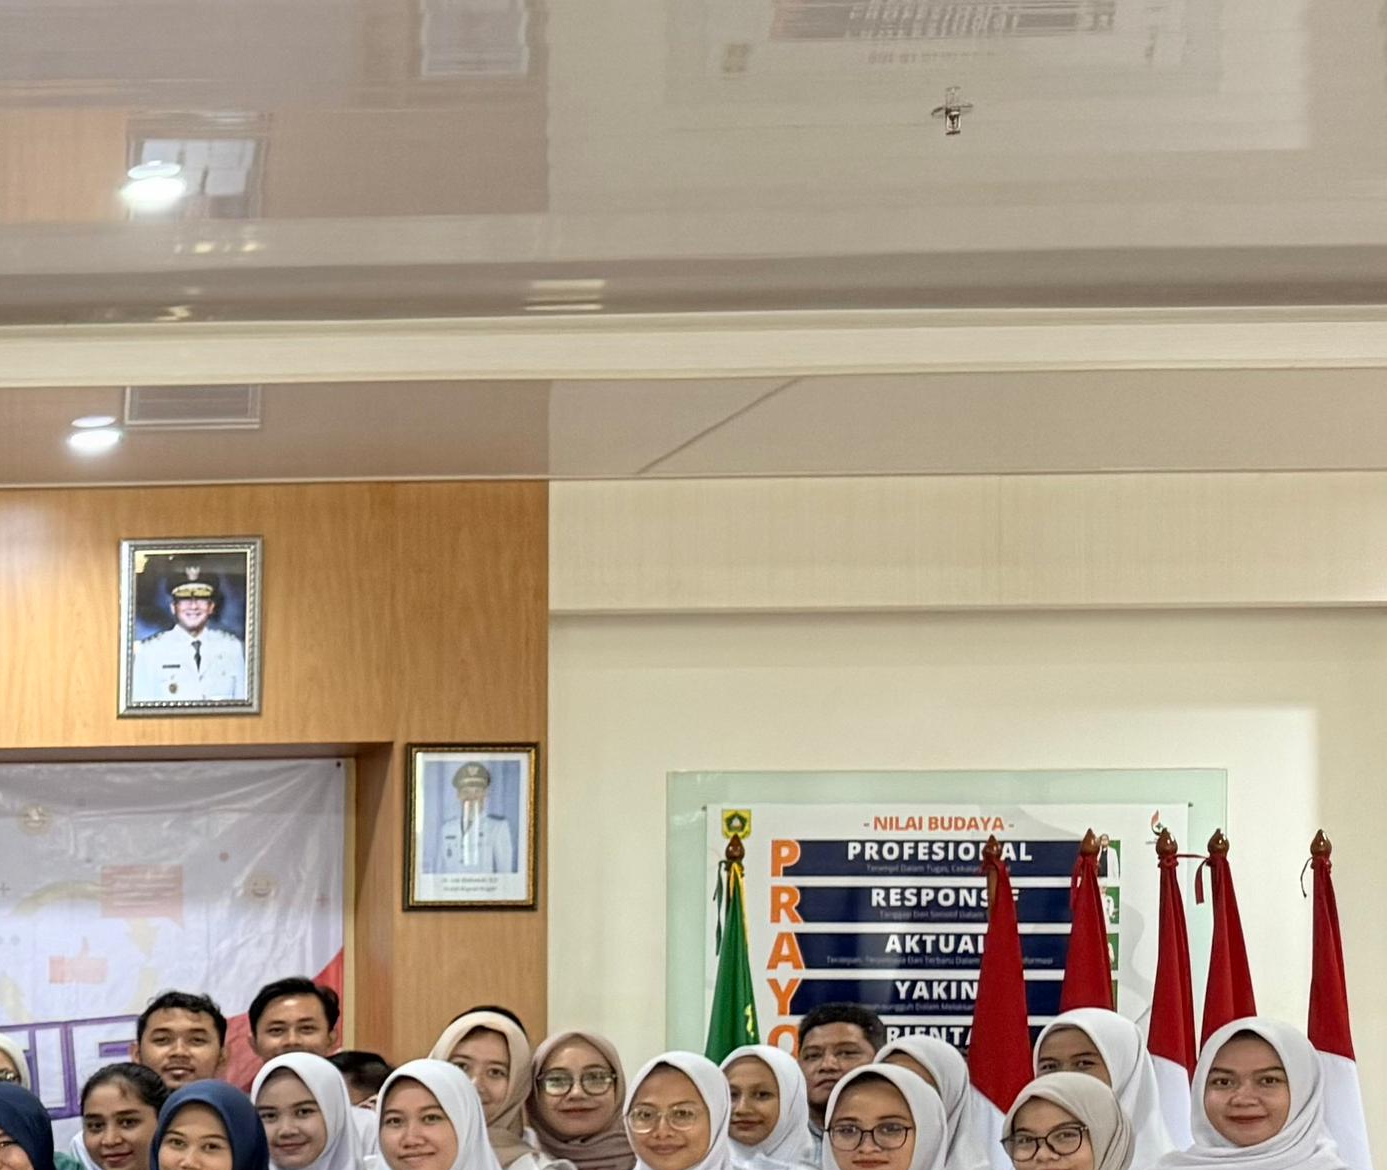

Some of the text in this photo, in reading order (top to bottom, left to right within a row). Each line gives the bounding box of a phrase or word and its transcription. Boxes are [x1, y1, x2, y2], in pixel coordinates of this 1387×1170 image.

[873, 816, 1005, 831] NILAI BUDAYA
[847, 842, 1032, 861] PROFESIOAL
[871, 888, 1020, 907] RESPONSF
[895, 981, 978, 1000] YAKIN
